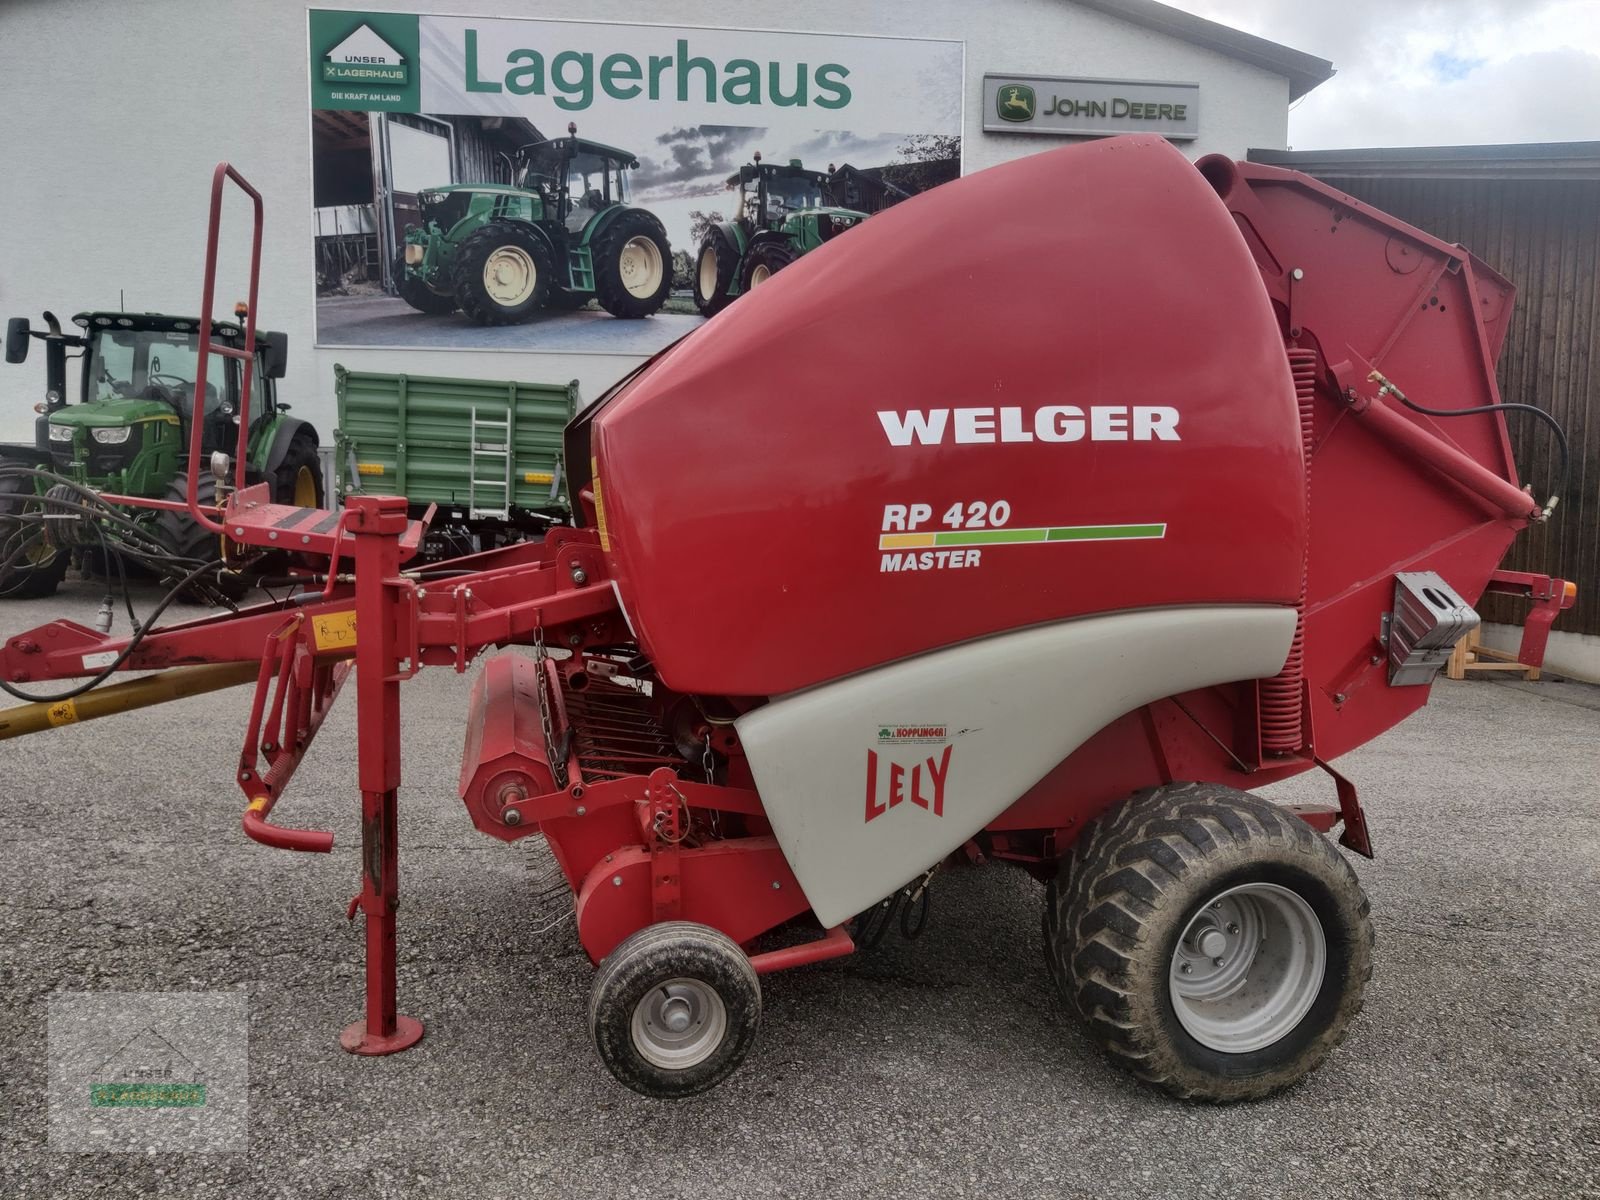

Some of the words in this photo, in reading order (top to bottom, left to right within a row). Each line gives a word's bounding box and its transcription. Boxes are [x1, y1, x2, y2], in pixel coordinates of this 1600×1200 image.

[345, 55, 385, 63] UNSER
[465, 28, 851, 111] Lagerhaus
[338, 69, 403, 78] LAGERHAUS
[331, 92, 343, 100] DIE
[344, 92, 368, 101] KRAFT
[381, 94, 401, 102] LAND
[1043, 95, 1106, 118] JOHN
[1111, 97, 1188, 121] DEERE
[877, 405, 1182, 447] WELGER
[881, 503, 933, 532] RP
[942, 500, 1011, 529] 420
[880, 549, 982, 573] MASTER
[865, 744, 953, 824] LELY
